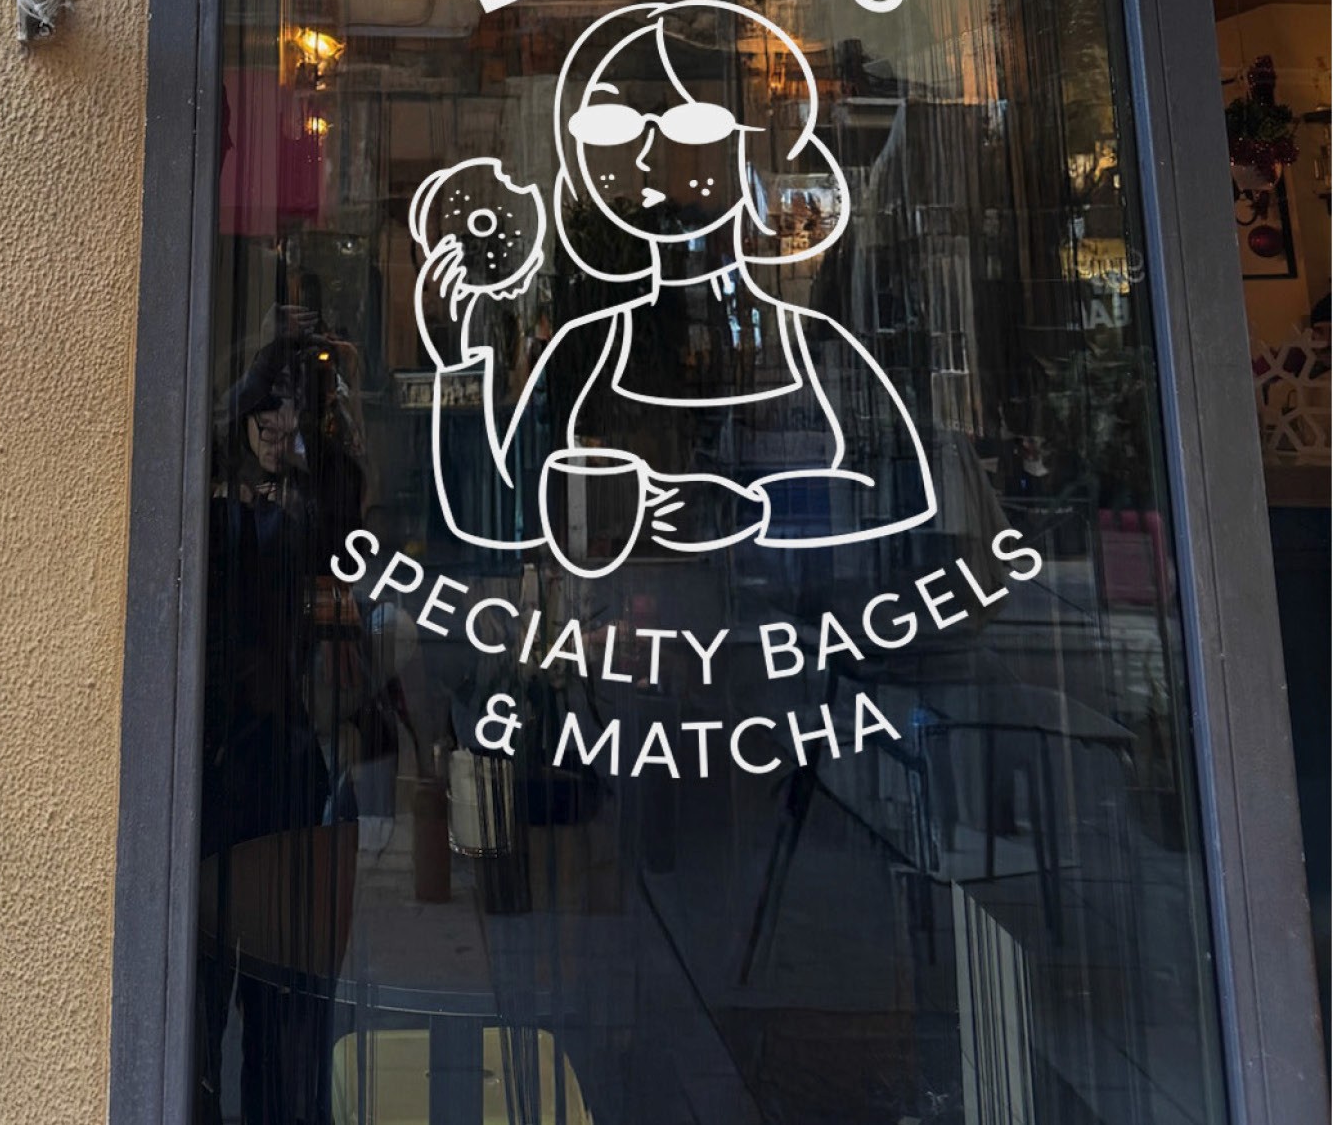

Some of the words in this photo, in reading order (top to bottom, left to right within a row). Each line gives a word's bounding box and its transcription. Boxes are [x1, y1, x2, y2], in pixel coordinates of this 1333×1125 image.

[330, 529, 727, 685] SPECIALTY
[762, 528, 1044, 680] BAGELS
[475, 693, 523, 756] &
[552, 691, 902, 779] MATCHA
